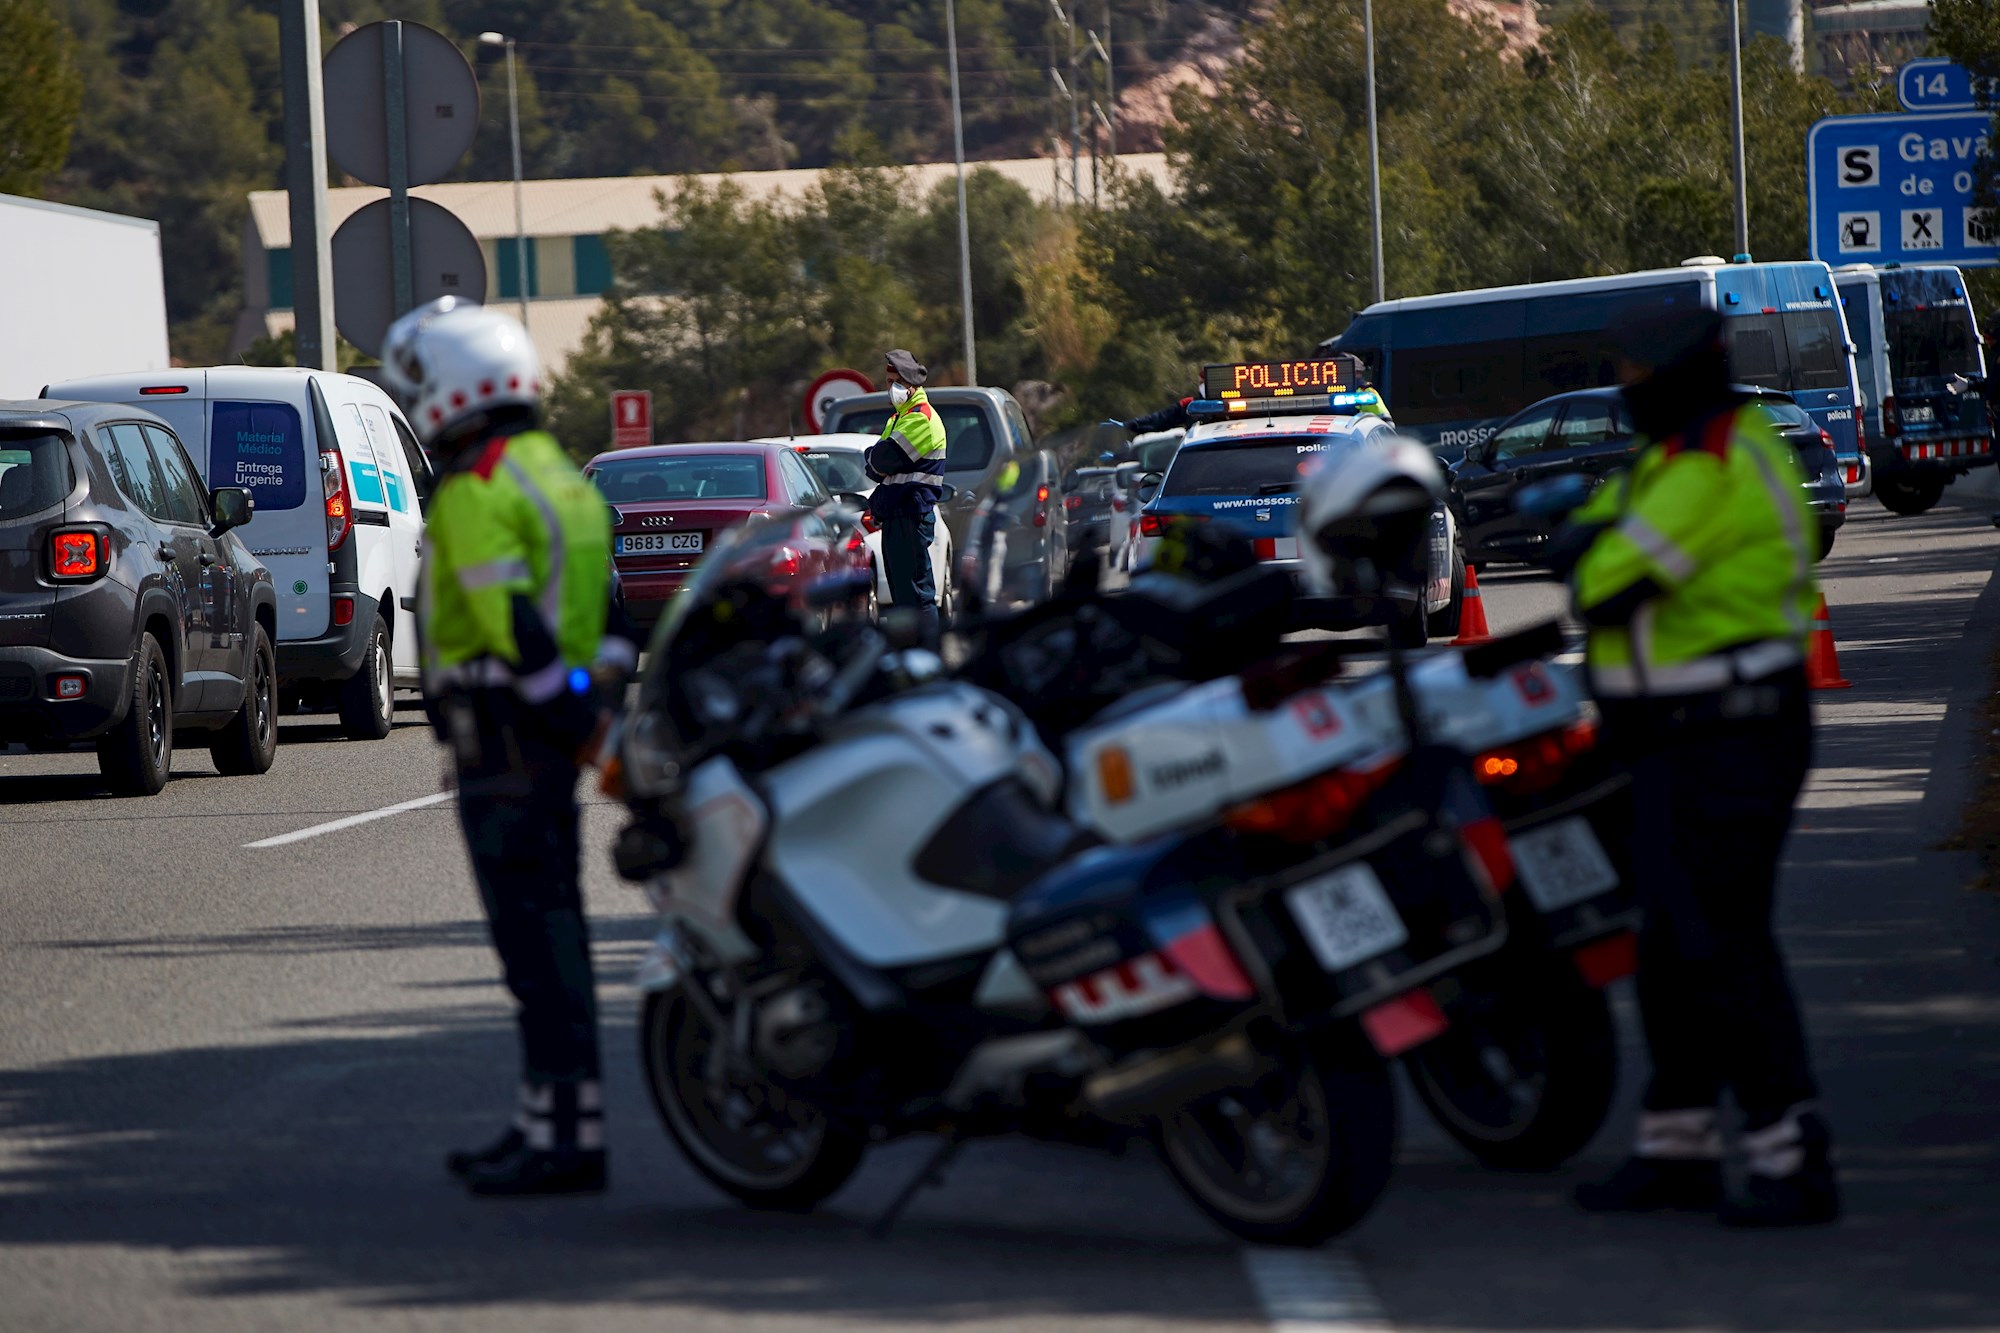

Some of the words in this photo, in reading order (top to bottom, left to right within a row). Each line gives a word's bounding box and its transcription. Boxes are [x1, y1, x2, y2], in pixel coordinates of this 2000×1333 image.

[1914, 73, 1948, 97] 14
[1899, 129, 1993, 163] Gavà
[1844, 149, 1873, 183] S
[1900, 174, 1934, 195] de
[1234, 361, 1337, 389] POLICIA
[237, 432, 285, 443] Material
[238, 443, 282, 455] Médico
[1296, 444, 1332, 454] polici
[236, 461, 283, 476] Entrega
[235, 473, 284, 487] Urgente
[1213, 497, 1302, 509] www.mossos.c
[624, 536, 664, 551] 9683
[672, 534, 699, 549] CZG
[252, 546, 312, 557] RENAULT
